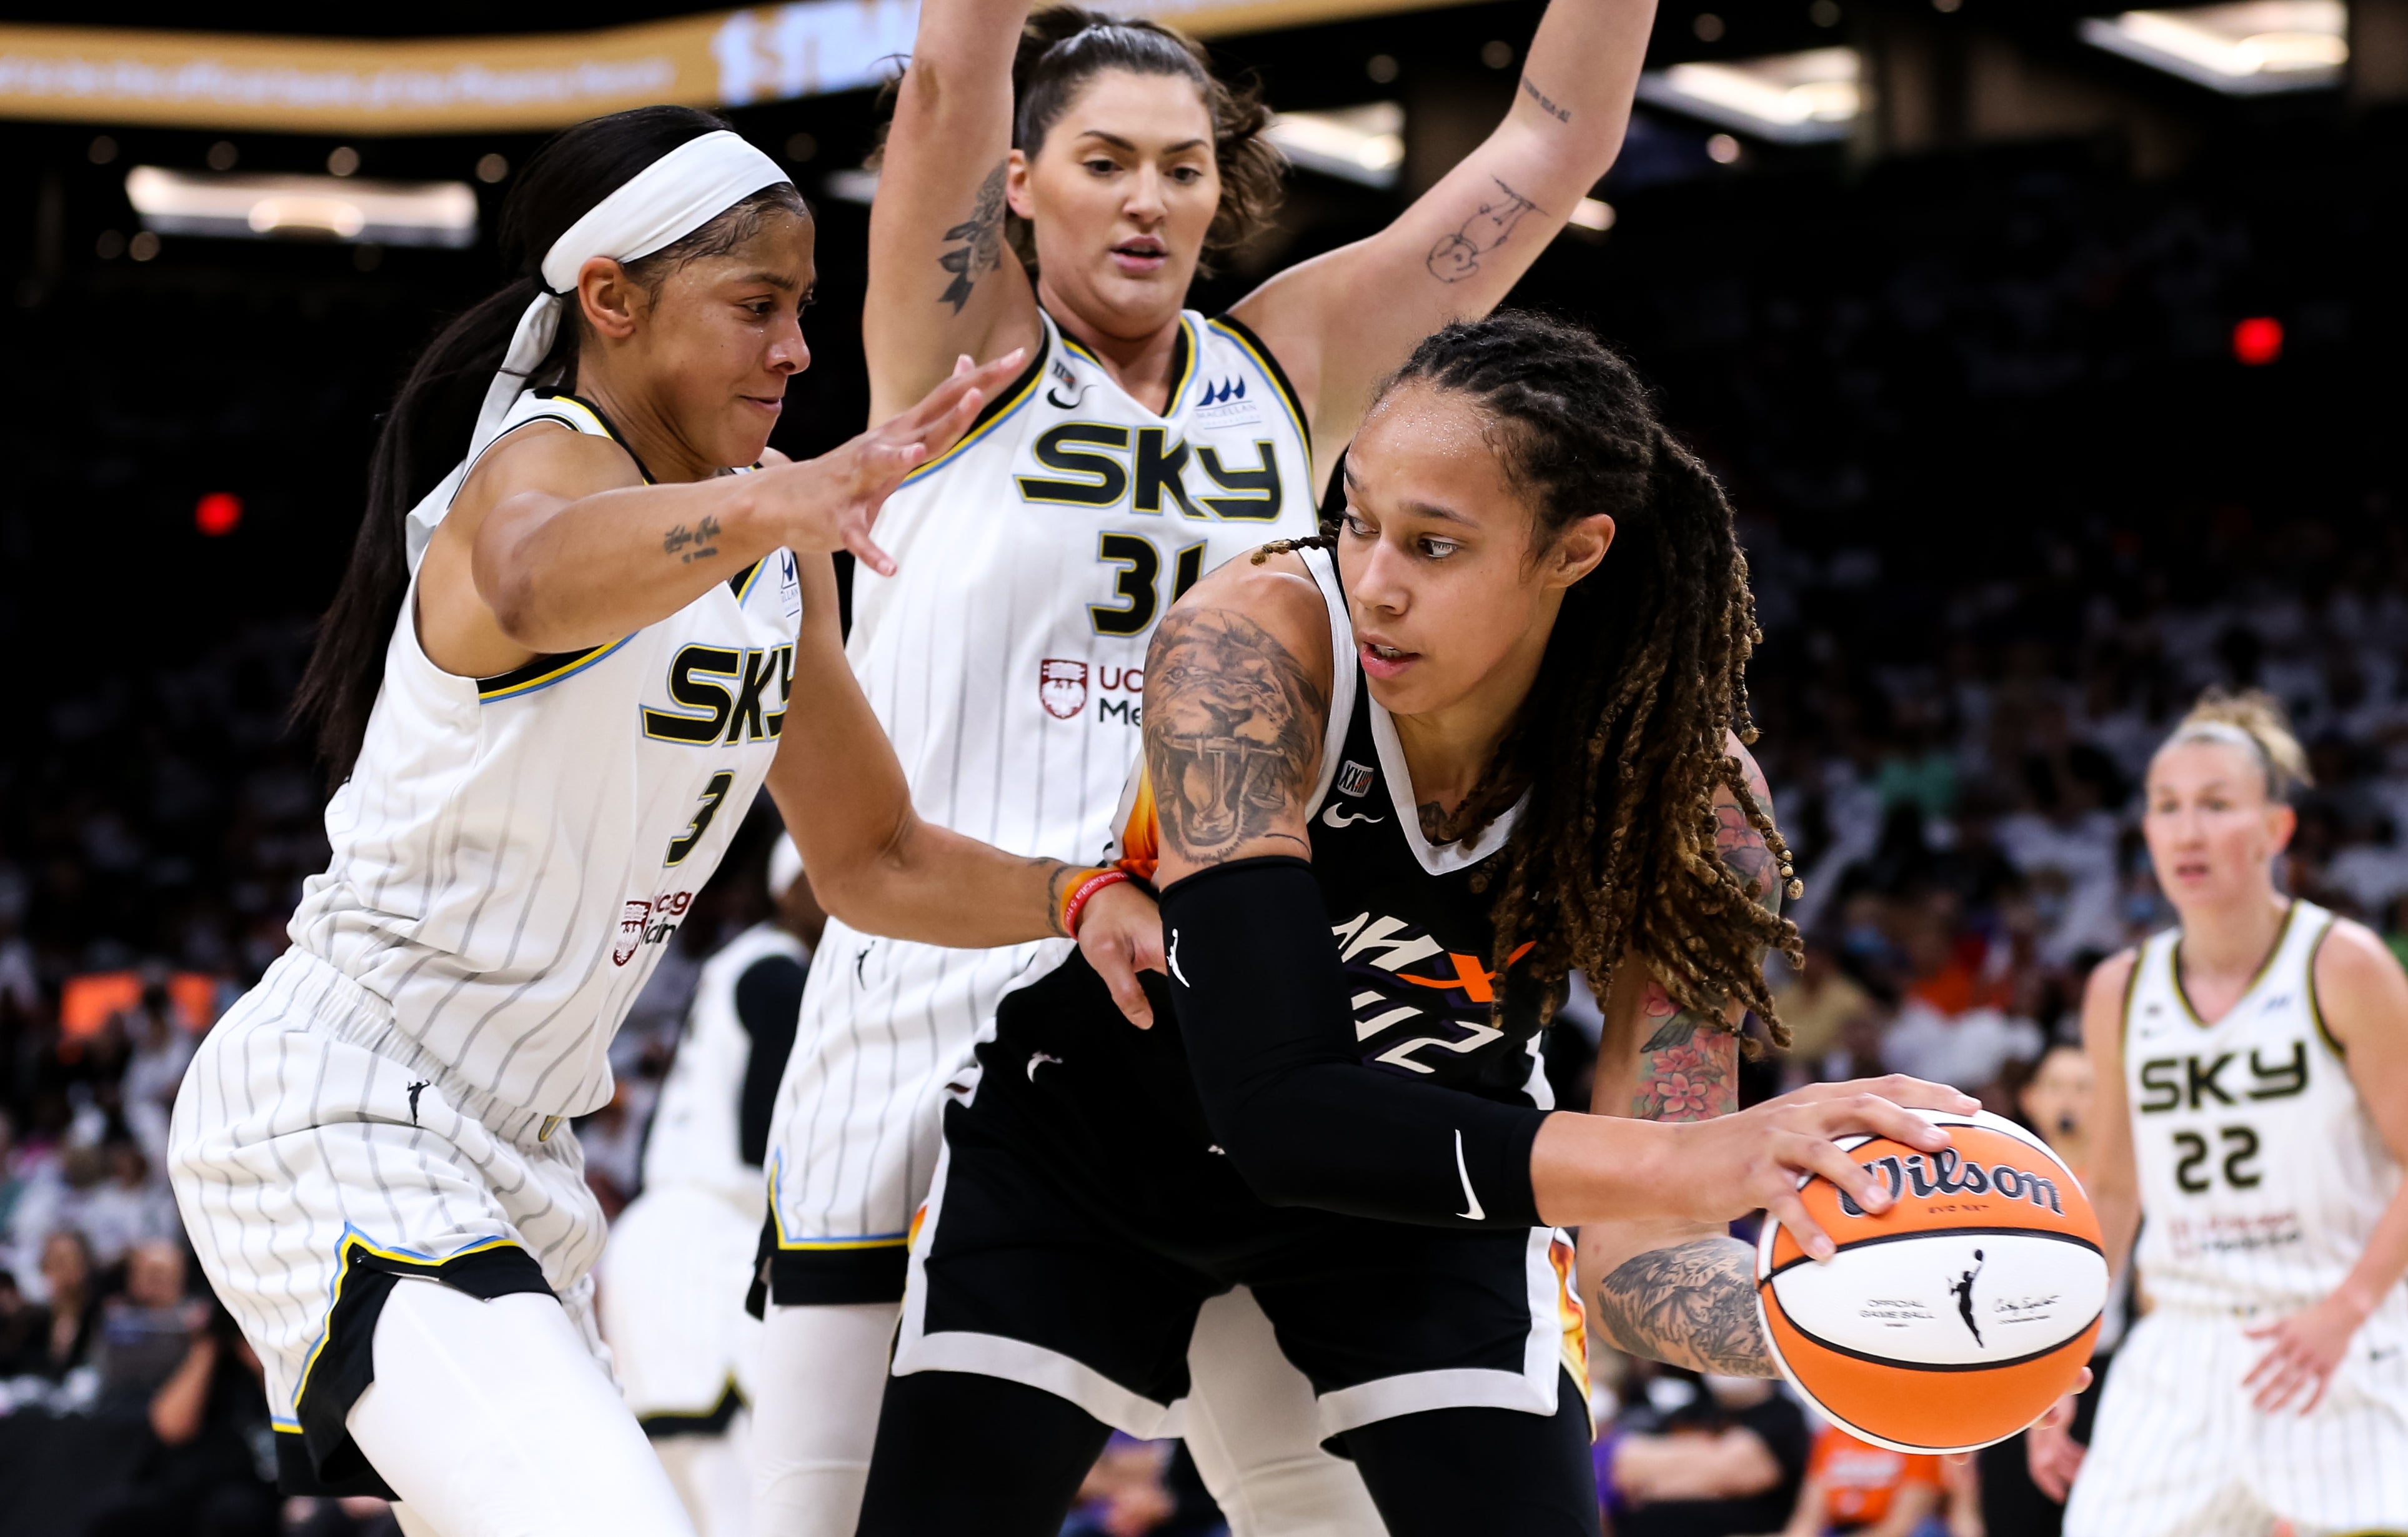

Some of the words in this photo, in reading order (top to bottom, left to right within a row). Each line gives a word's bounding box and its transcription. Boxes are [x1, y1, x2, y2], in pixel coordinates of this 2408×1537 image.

[1013, 420, 1283, 524] SKY
[1099, 697, 1141, 727] Me
[1100, 665, 1143, 694] UC
[2139, 1040, 2309, 1113] SKY
[2173, 1125, 2262, 1195] 22
